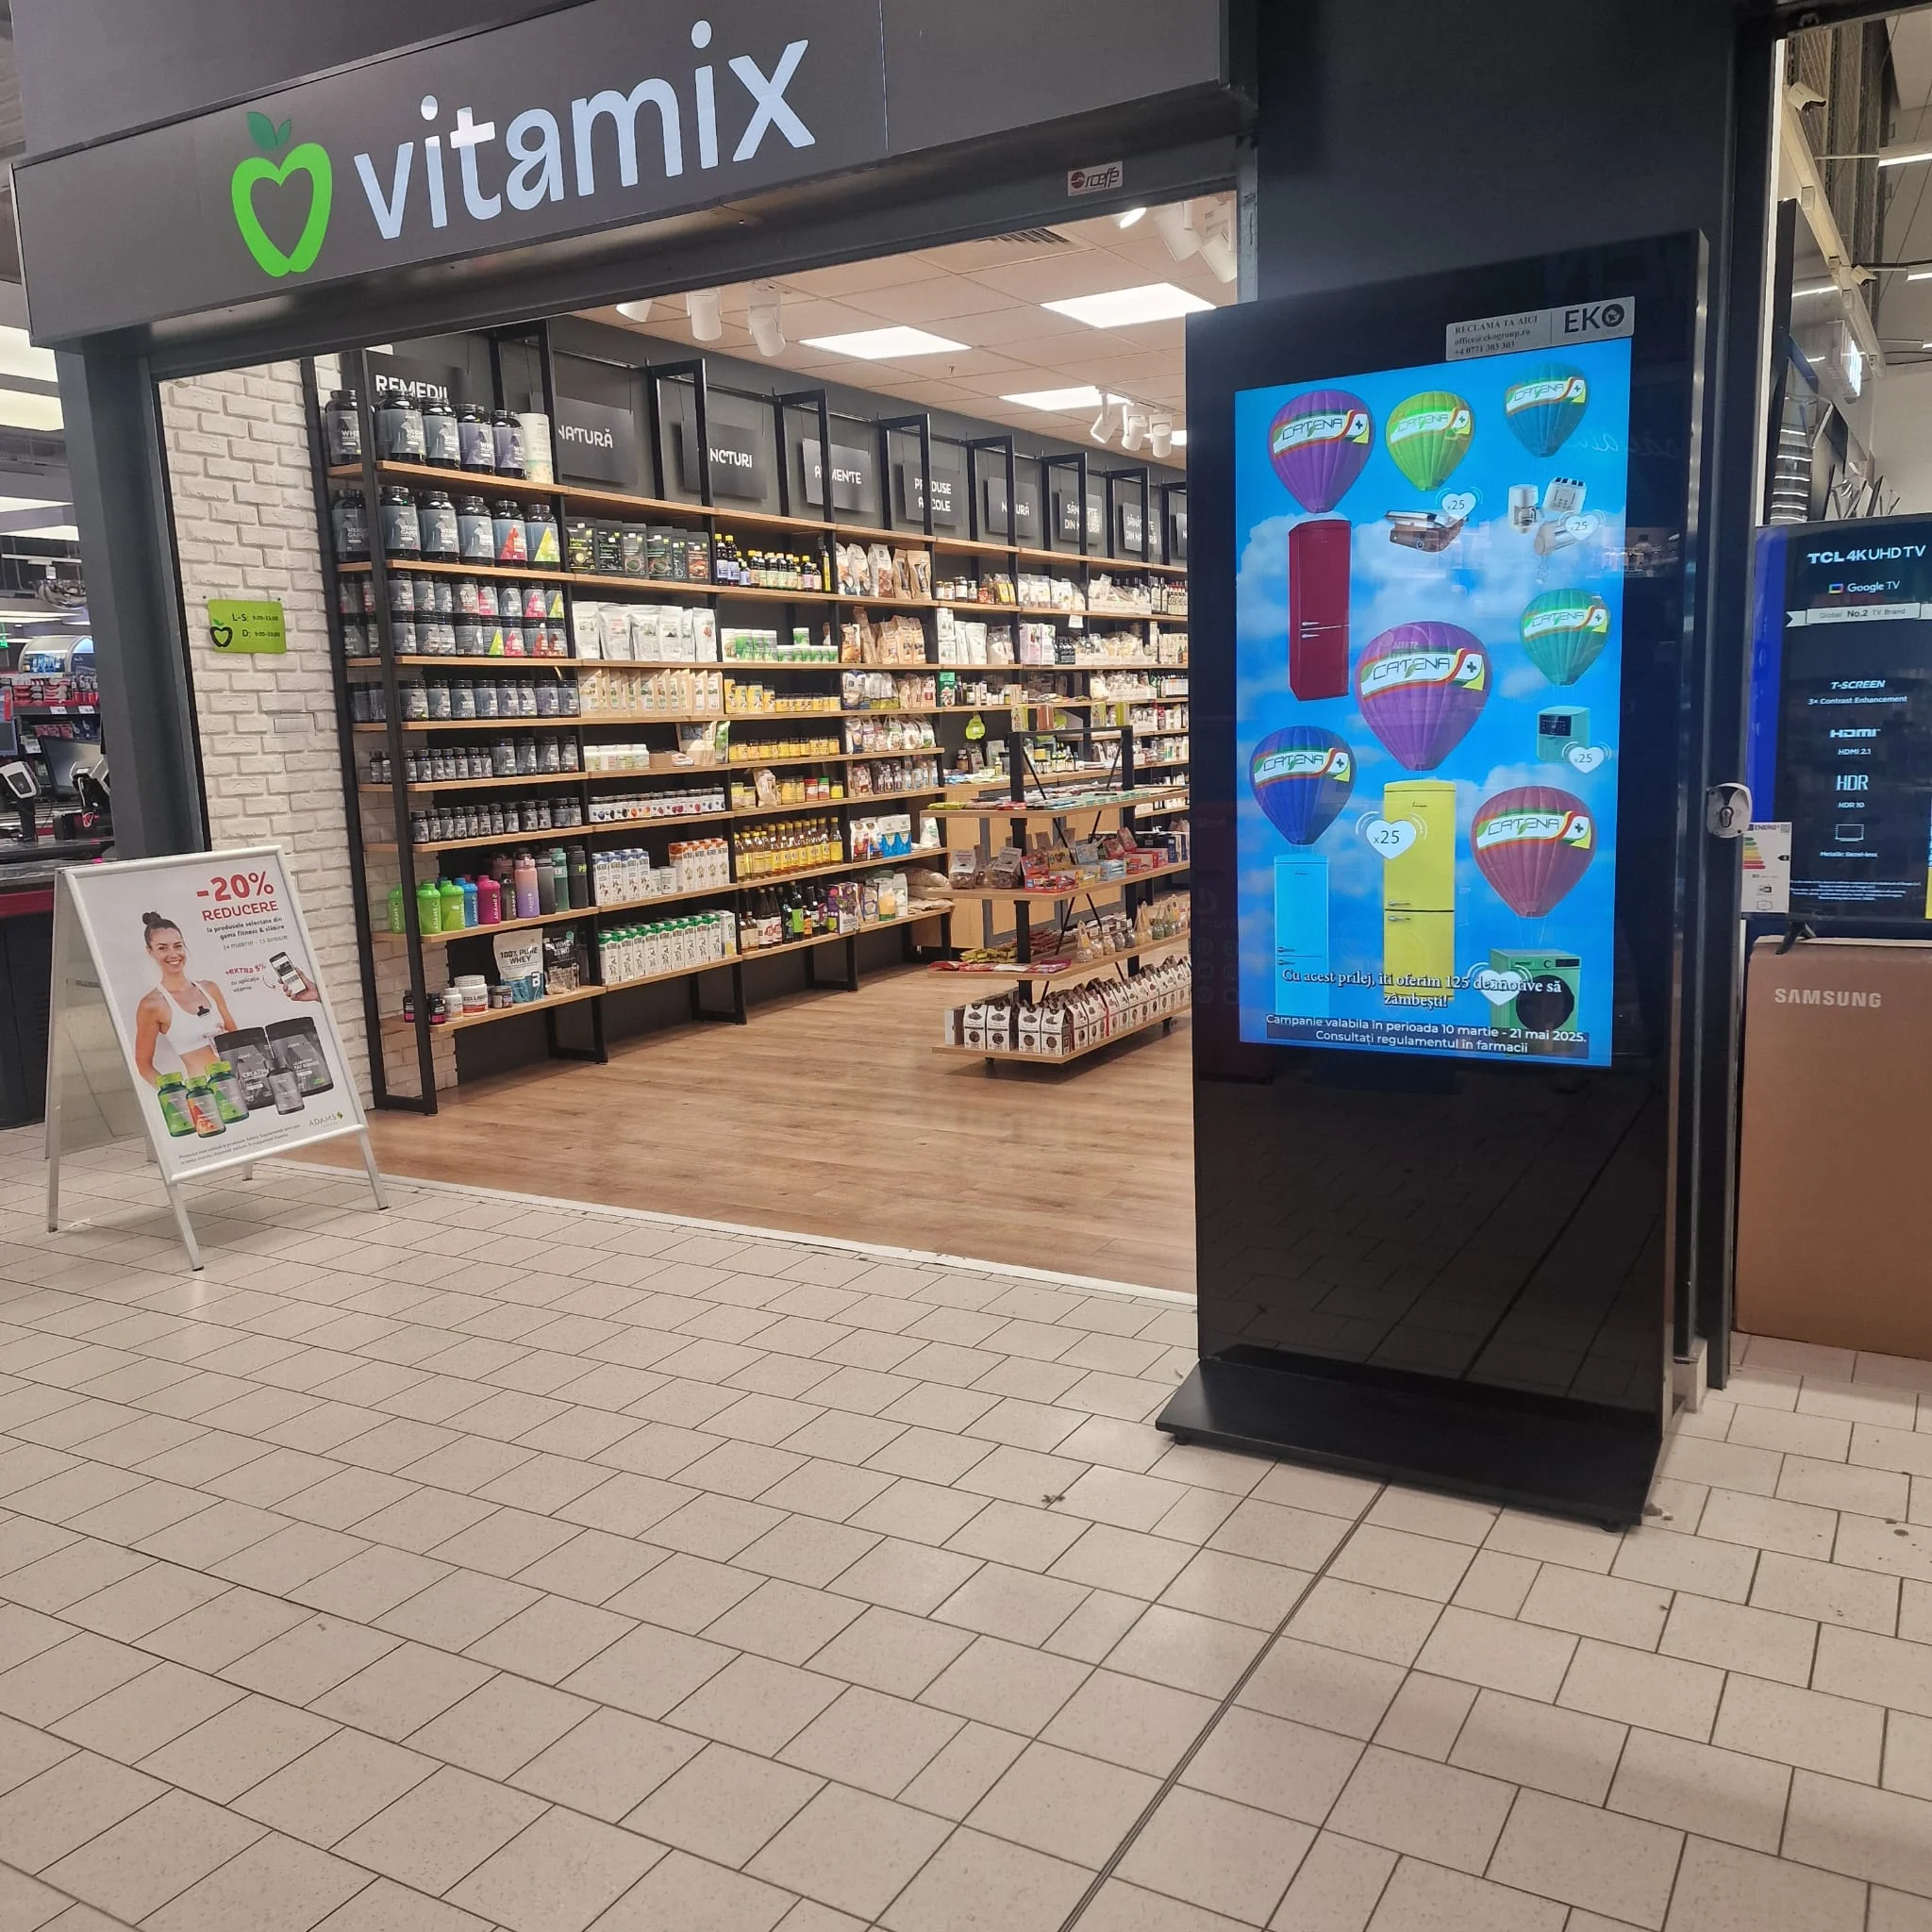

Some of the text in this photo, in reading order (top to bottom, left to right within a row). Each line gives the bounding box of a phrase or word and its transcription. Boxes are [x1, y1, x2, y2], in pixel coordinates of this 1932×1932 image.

[354, 19, 815, 240] vitamix
[1456, 315, 1538, 334] RECLAMA TA AICI
[1564, 303, 1624, 334] EKO
[1513, 381, 1565, 402] CATENA
[1282, 418, 1342, 441] CATENA
[1398, 411, 1449, 432] CATENA
[1807, 545, 1926, 564] TCL 4K UHD TV
[1847, 580, 1900, 593] Google TV
[1532, 610, 1584, 627] CATENA
[1847, 609, 1868, 618] No.2
[1373, 657, 1451, 680] CATENA
[1830, 680, 1886, 690] T-SCREEN
[1263, 754, 1324, 772] CATENA
[1835, 774, 1869, 791] HDR
[1374, 829, 1400, 844] x25
[1488, 817, 1559, 837] CATENA
[196, 871, 275, 902] -20%
[202, 901, 278, 921] REDUCERE
[213, 922, 244, 933] produsele
[245, 919, 272, 927] selectate
[220, 933, 236, 941] gama
[500, 949, 518, 959] 100%
[509, 955, 532, 965] WHEY
[1282, 969, 1300, 981] Cu
[1304, 970, 1335, 982] acest
[1338, 971, 1375, 988] prilej,
[1396, 974, 1441, 988] oferim
[1446, 976, 1469, 989] 125
[1546, 980, 1562, 992] să
[1774, 988, 1882, 1008] SAMSUNG
[1266, 1014, 1323, 1026] Campanie
[1324, 1018, 1369, 1029] valabila
[1386, 1021, 1439, 1034] perioada
[1441, 1024, 1455, 1035] 10
[1457, 1025, 1499, 1038] martie
[1509, 1028, 1522, 1038] 21
[1524, 1029, 1550, 1040] mai
[1553, 1030, 1587, 1042] 2025.
[1315, 1030, 1528, 1053] Consultați regulamentul în farmacii
[308, 1114, 337, 1127] ADAMS
